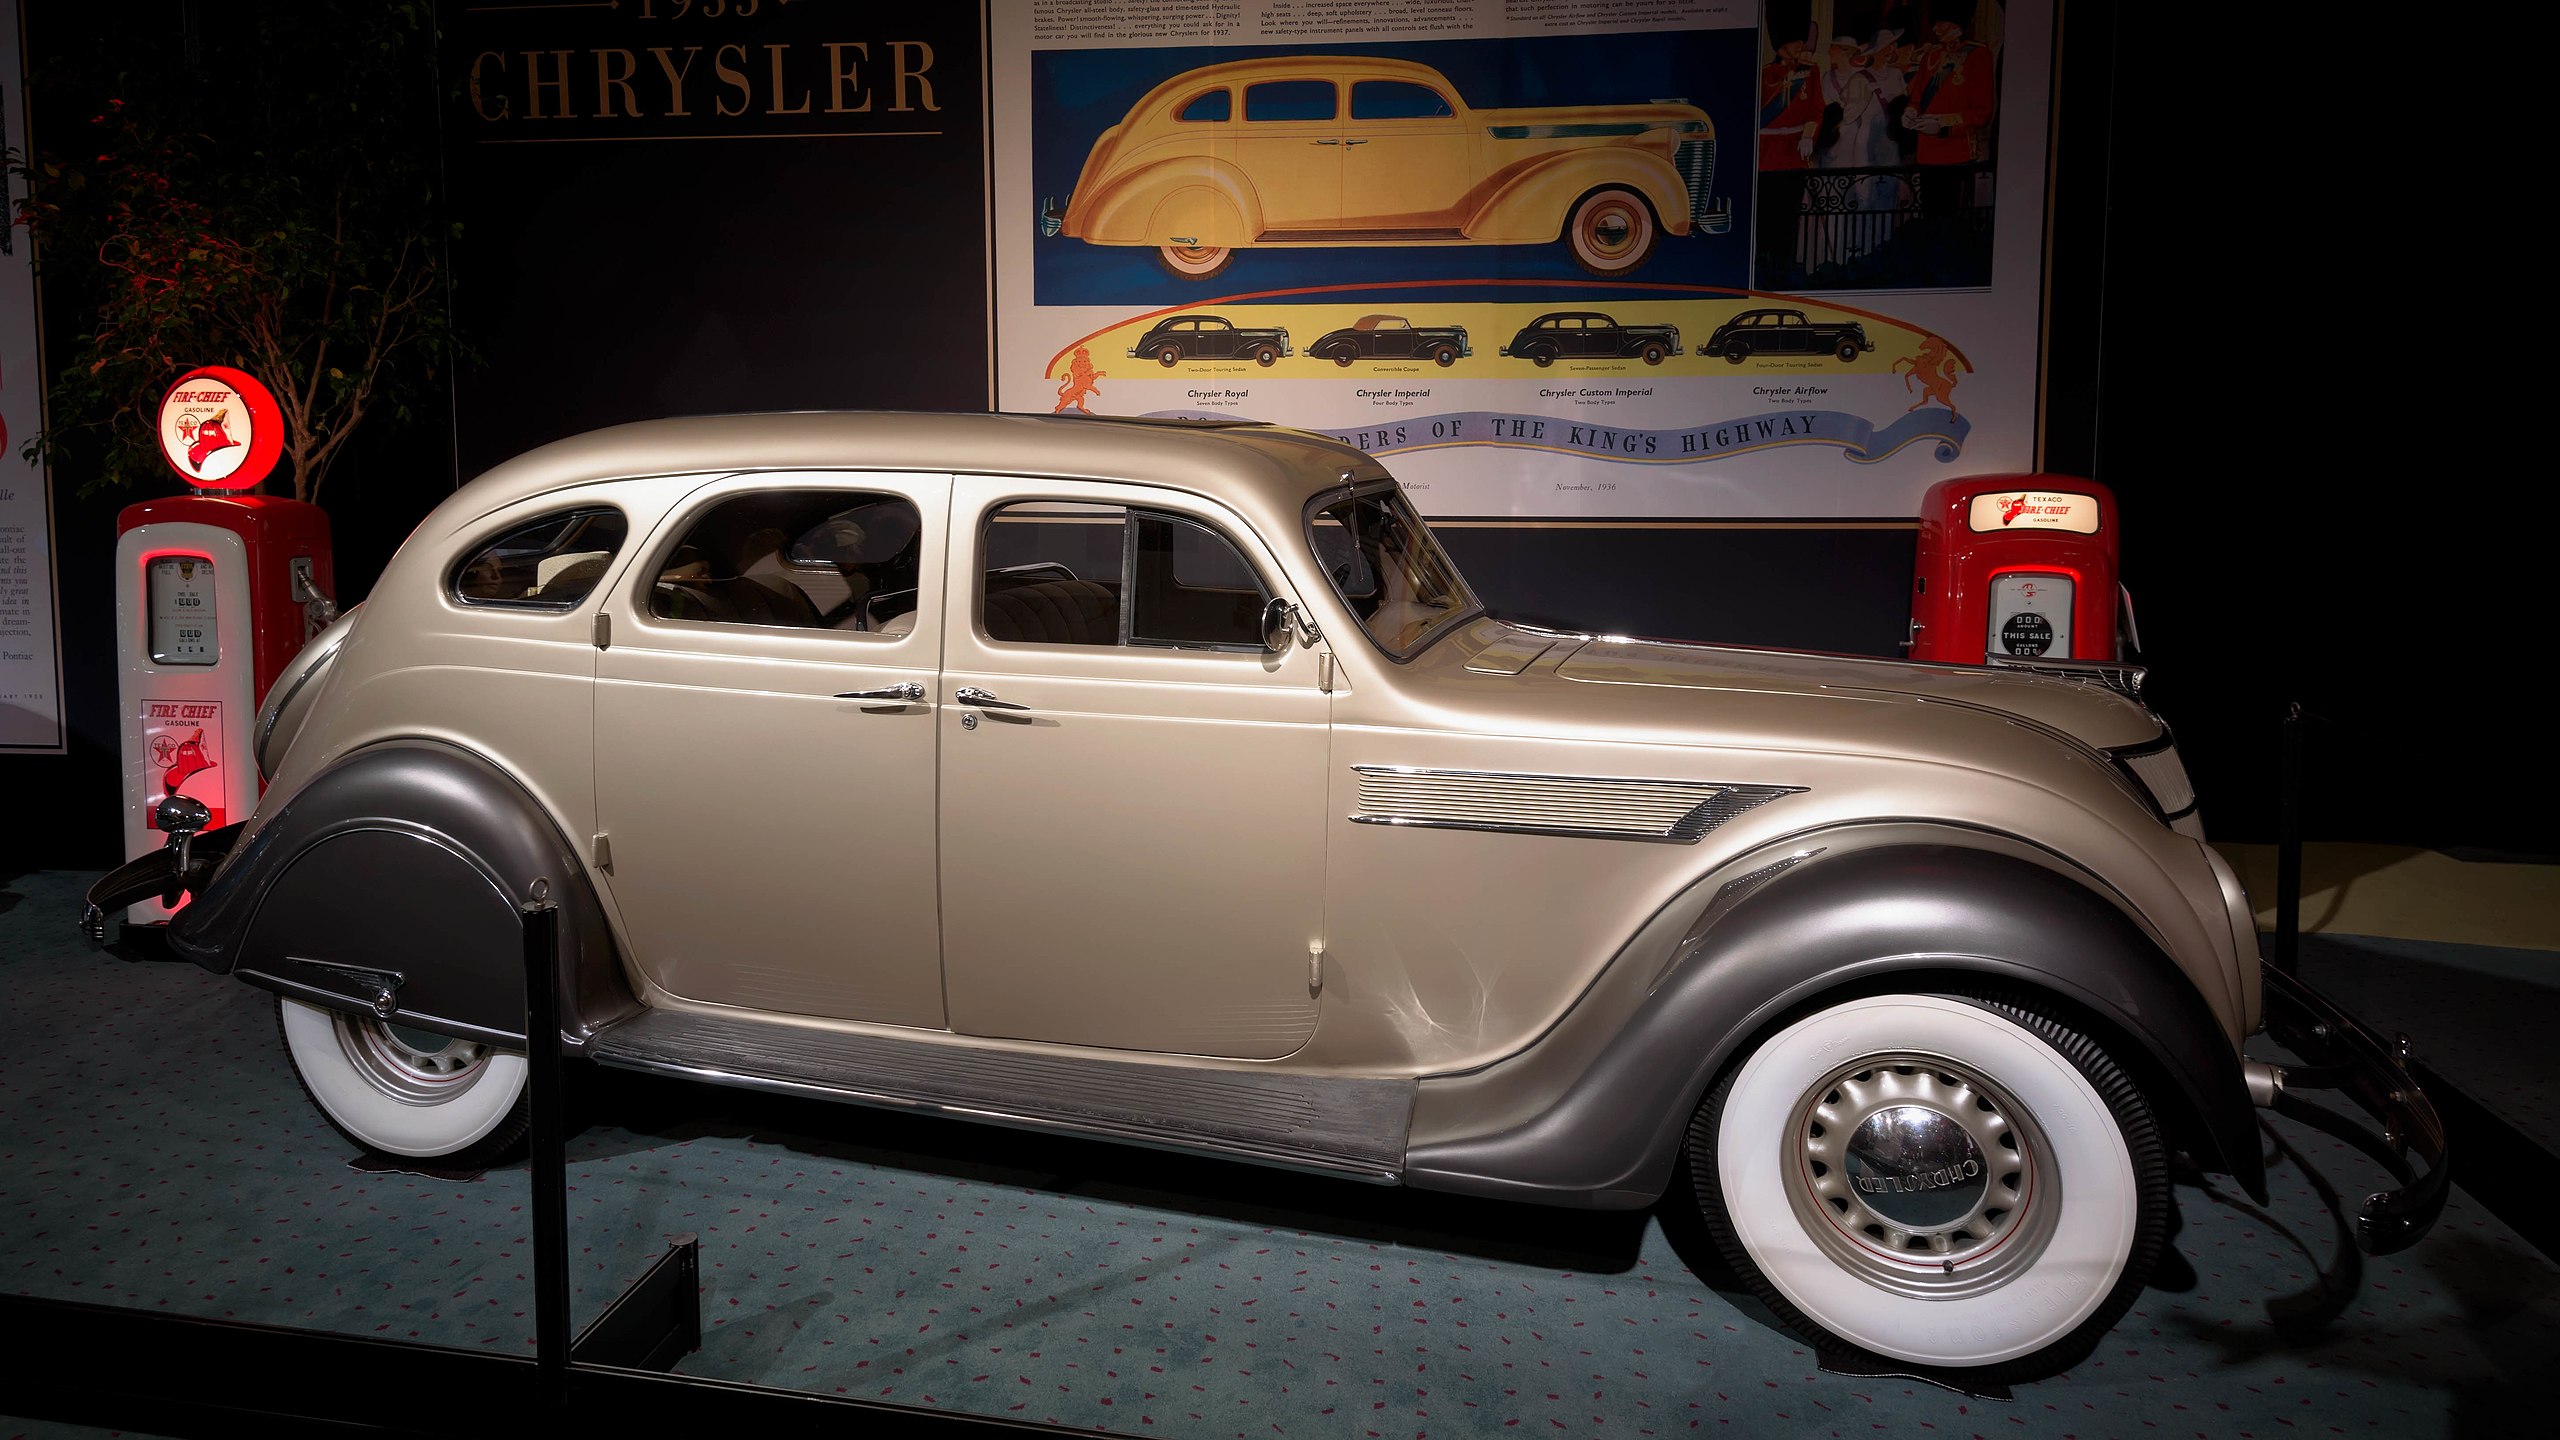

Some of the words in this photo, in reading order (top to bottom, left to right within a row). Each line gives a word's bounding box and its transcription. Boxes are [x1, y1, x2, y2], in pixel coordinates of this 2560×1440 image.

[1057, 6, 1082, 15] Chrysler
[1128, 5, 1160, 14] safety-glass
[1212, 3, 1240, 12] Hydraulic
[1537, 2, 1568, 12] perfection
[1581, 1, 1609, 10] motoring
[1163, 13, 1184, 21] surging
[1216, 12, 1240, 20] Dignity!
[1262, 11, 1274, 19] high
[1340, 8, 1372, 17] upholstery
[1135, 22, 1166, 30] everything
[1275, 27, 1307, 35] safety-type
[1346, 25, 1363, 34] panels
[1129, 30, 1152, 39] glorious
[1171, 30, 1198, 38] Chryslers
[469, 42, 942, 121] CHRYSLER
[173, 392, 231, 402] FIRE-CHIEF
[1188, 390, 1222, 399] Chrysler
[1225, 389, 1249, 399] Royal
[1356, 389, 1392, 400] Chrysler
[1395, 389, 1430, 399] Imperial
[1540, 389, 1576, 399] Chrysler
[1615, 388, 1653, 398] Imperial
[1753, 387, 1791, 397] Chrysler
[1795, 386, 1828, 396] Airflow
[1432, 420, 1462, 438] OF
[1491, 418, 1544, 439] THE
[1568, 426, 1656, 454] KING'S
[1681, 415, 1816, 452] HIGHWAY
[1556, 483, 1593, 491] November,
[11, 588, 28, 596] great
[3, 651, 33, 660] Pontiac
[149, 704, 178, 717] FIRE
[181, 705, 217, 718] CHIEF
[1856, 1159, 1979, 1192] CHRYSLER
